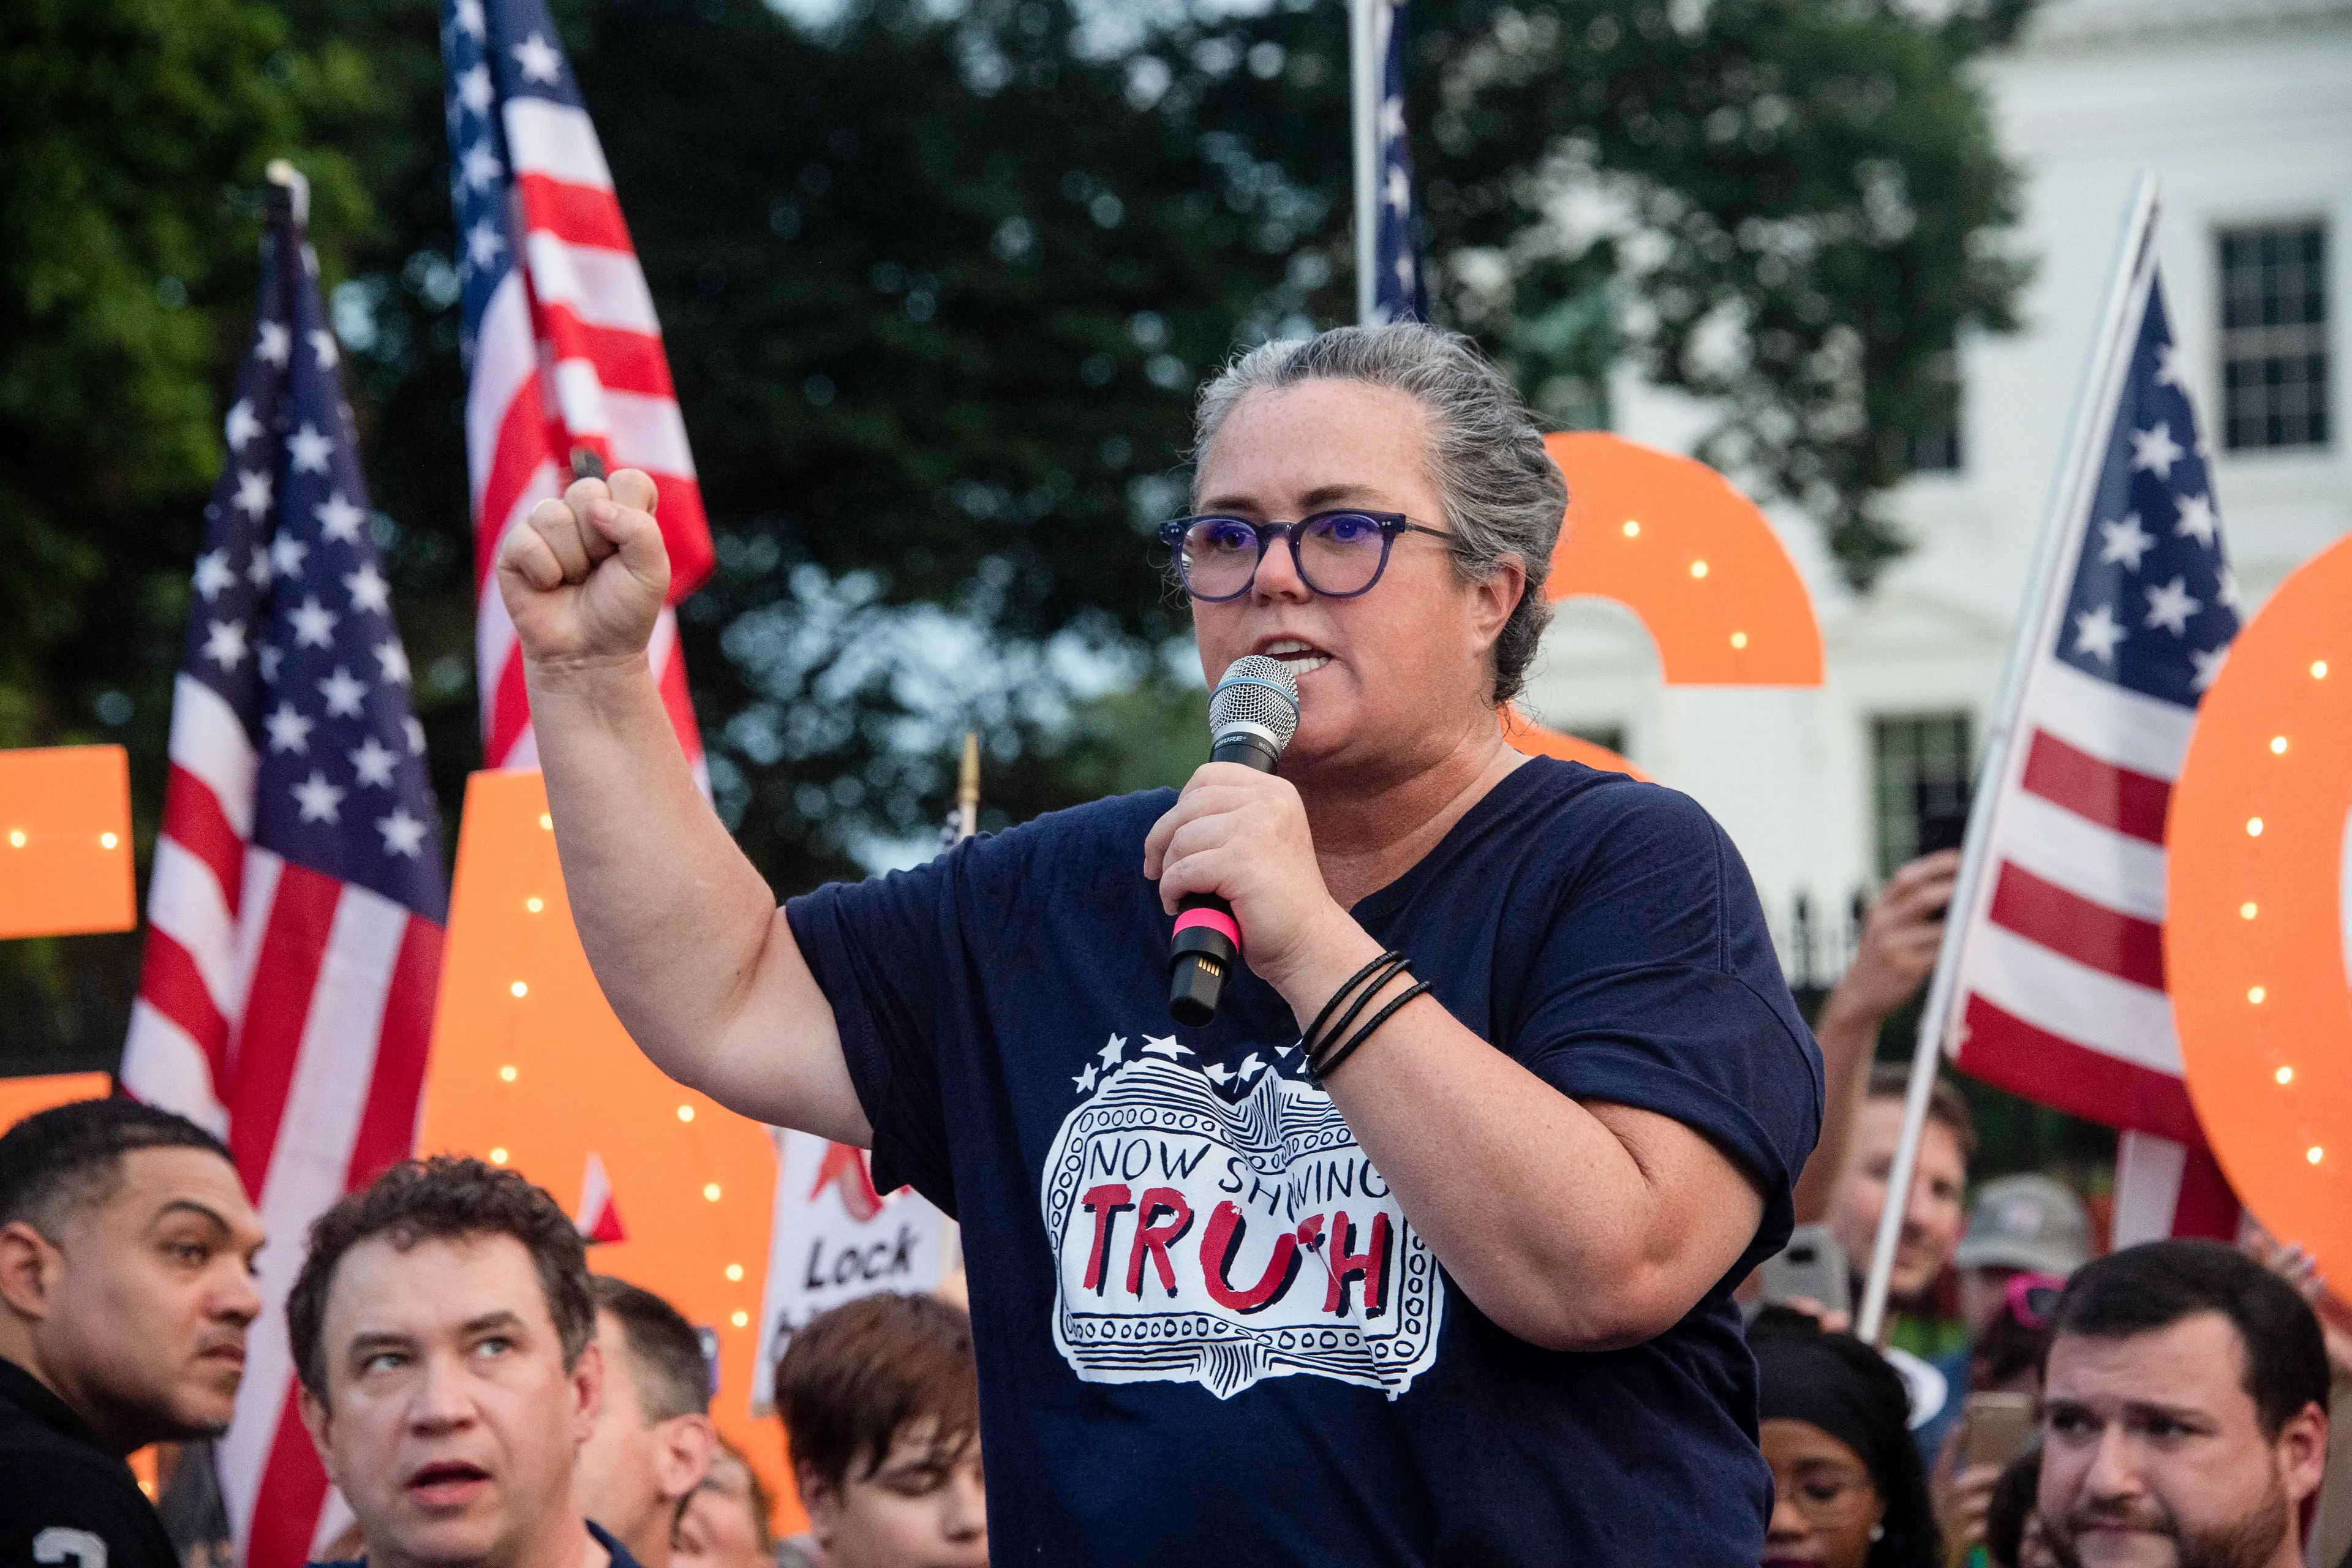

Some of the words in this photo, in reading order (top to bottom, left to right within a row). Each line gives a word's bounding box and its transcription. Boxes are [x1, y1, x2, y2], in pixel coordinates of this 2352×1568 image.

[1259, 742, 1272, 754] BETA
[1089, 1139, 1211, 1181] NOW
[1218, 1156, 1391, 1224] SHWING
